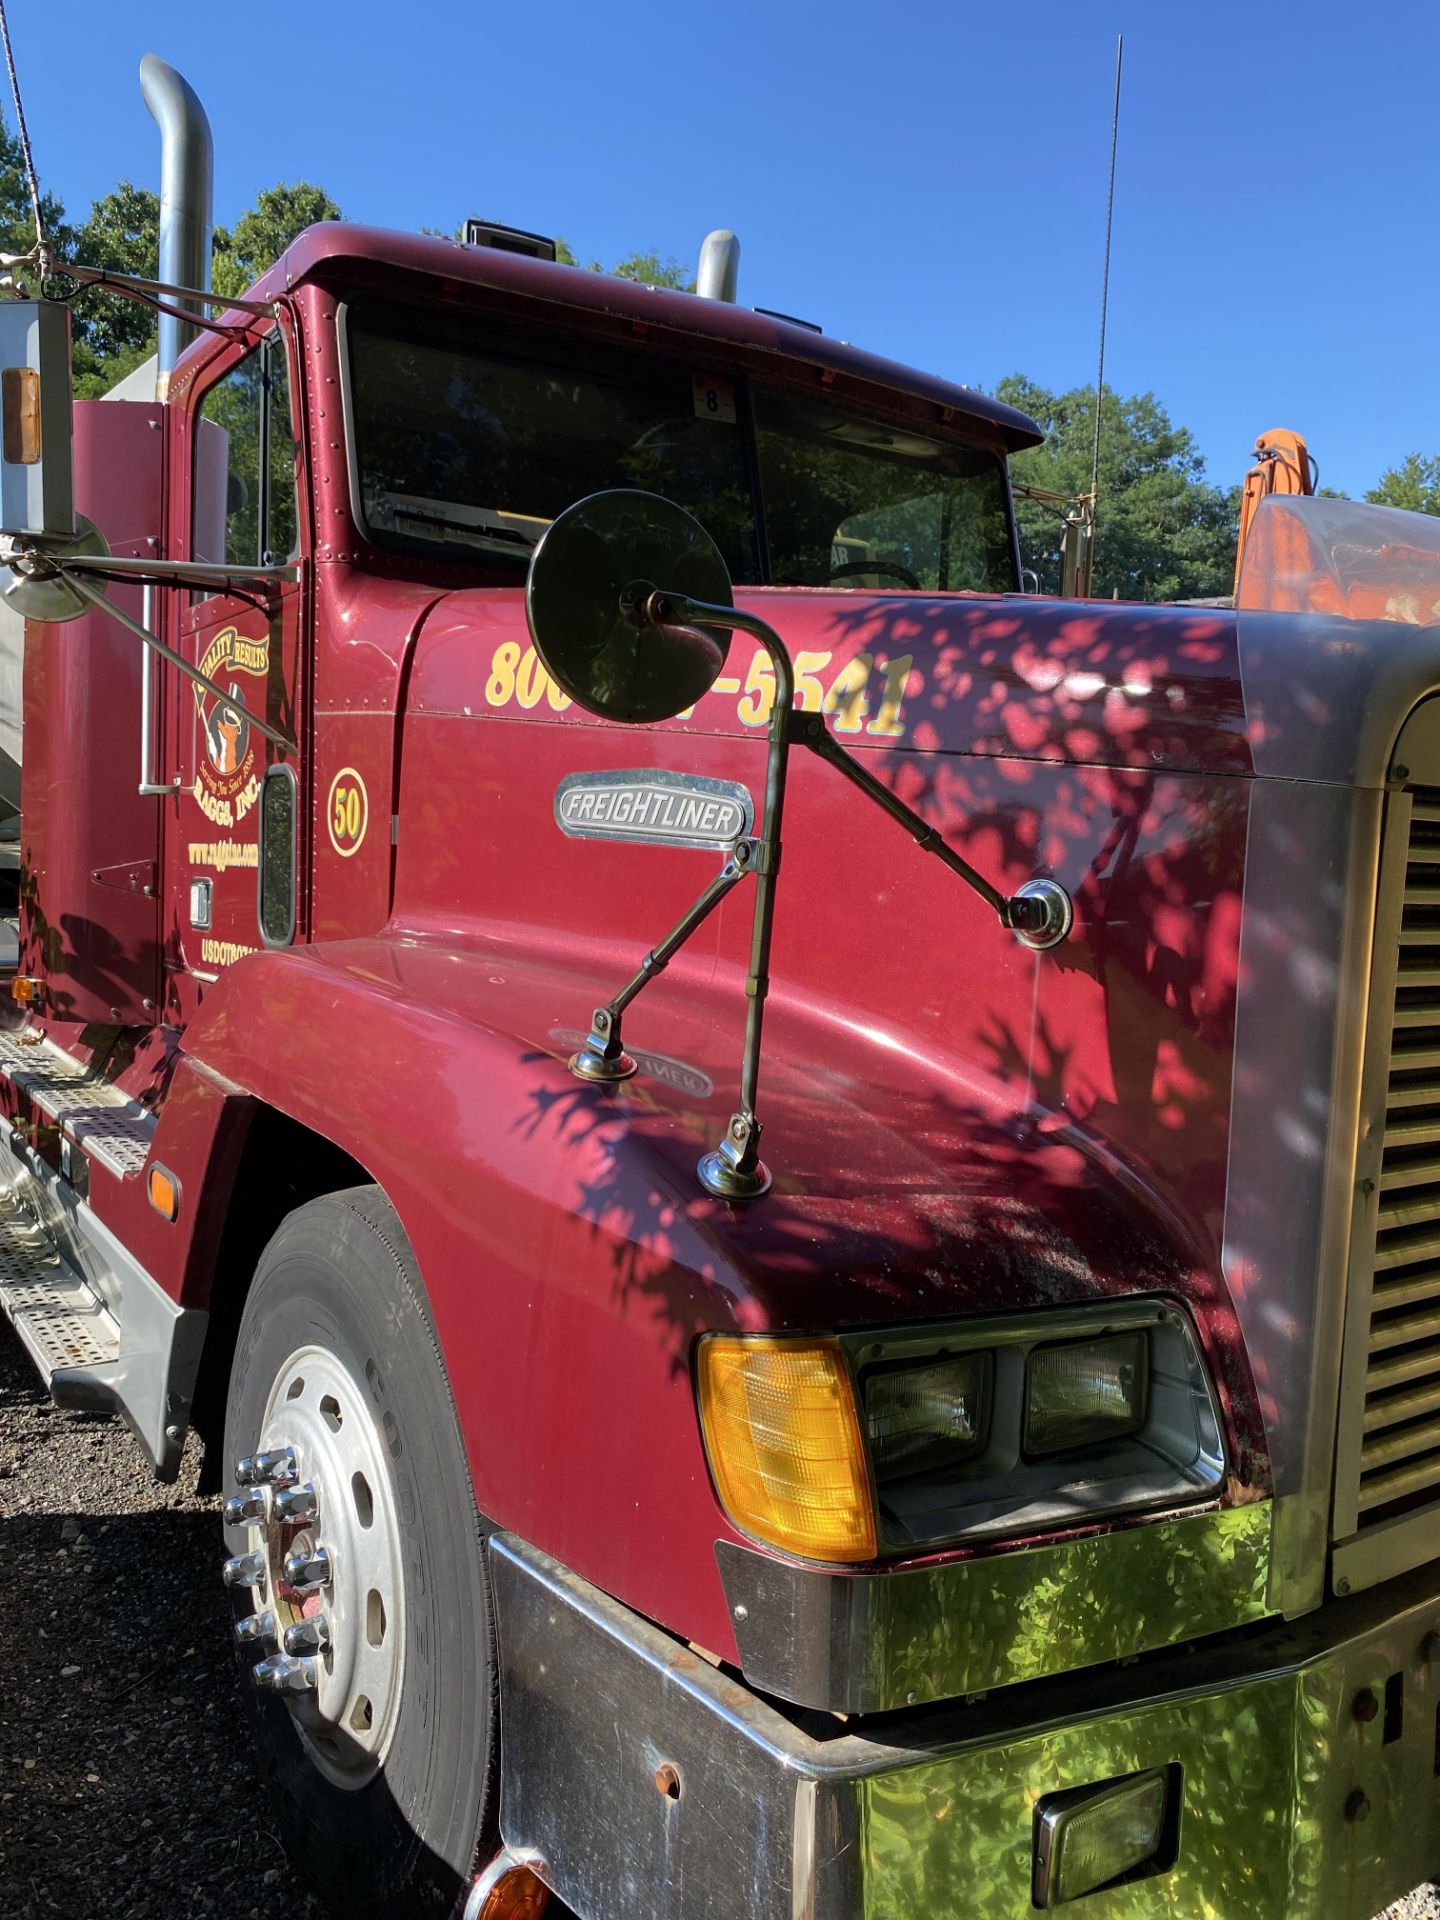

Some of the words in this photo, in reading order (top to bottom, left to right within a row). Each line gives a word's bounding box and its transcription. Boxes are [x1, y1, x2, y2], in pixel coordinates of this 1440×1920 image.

[706, 390, 717, 412] 8
[234, 642, 266, 668] RESULTS
[228, 775, 242, 794] Since
[235, 773, 262, 821] INC.
[333, 787, 361, 839] 50
[566, 791, 733, 833] FREIGHTLINER
